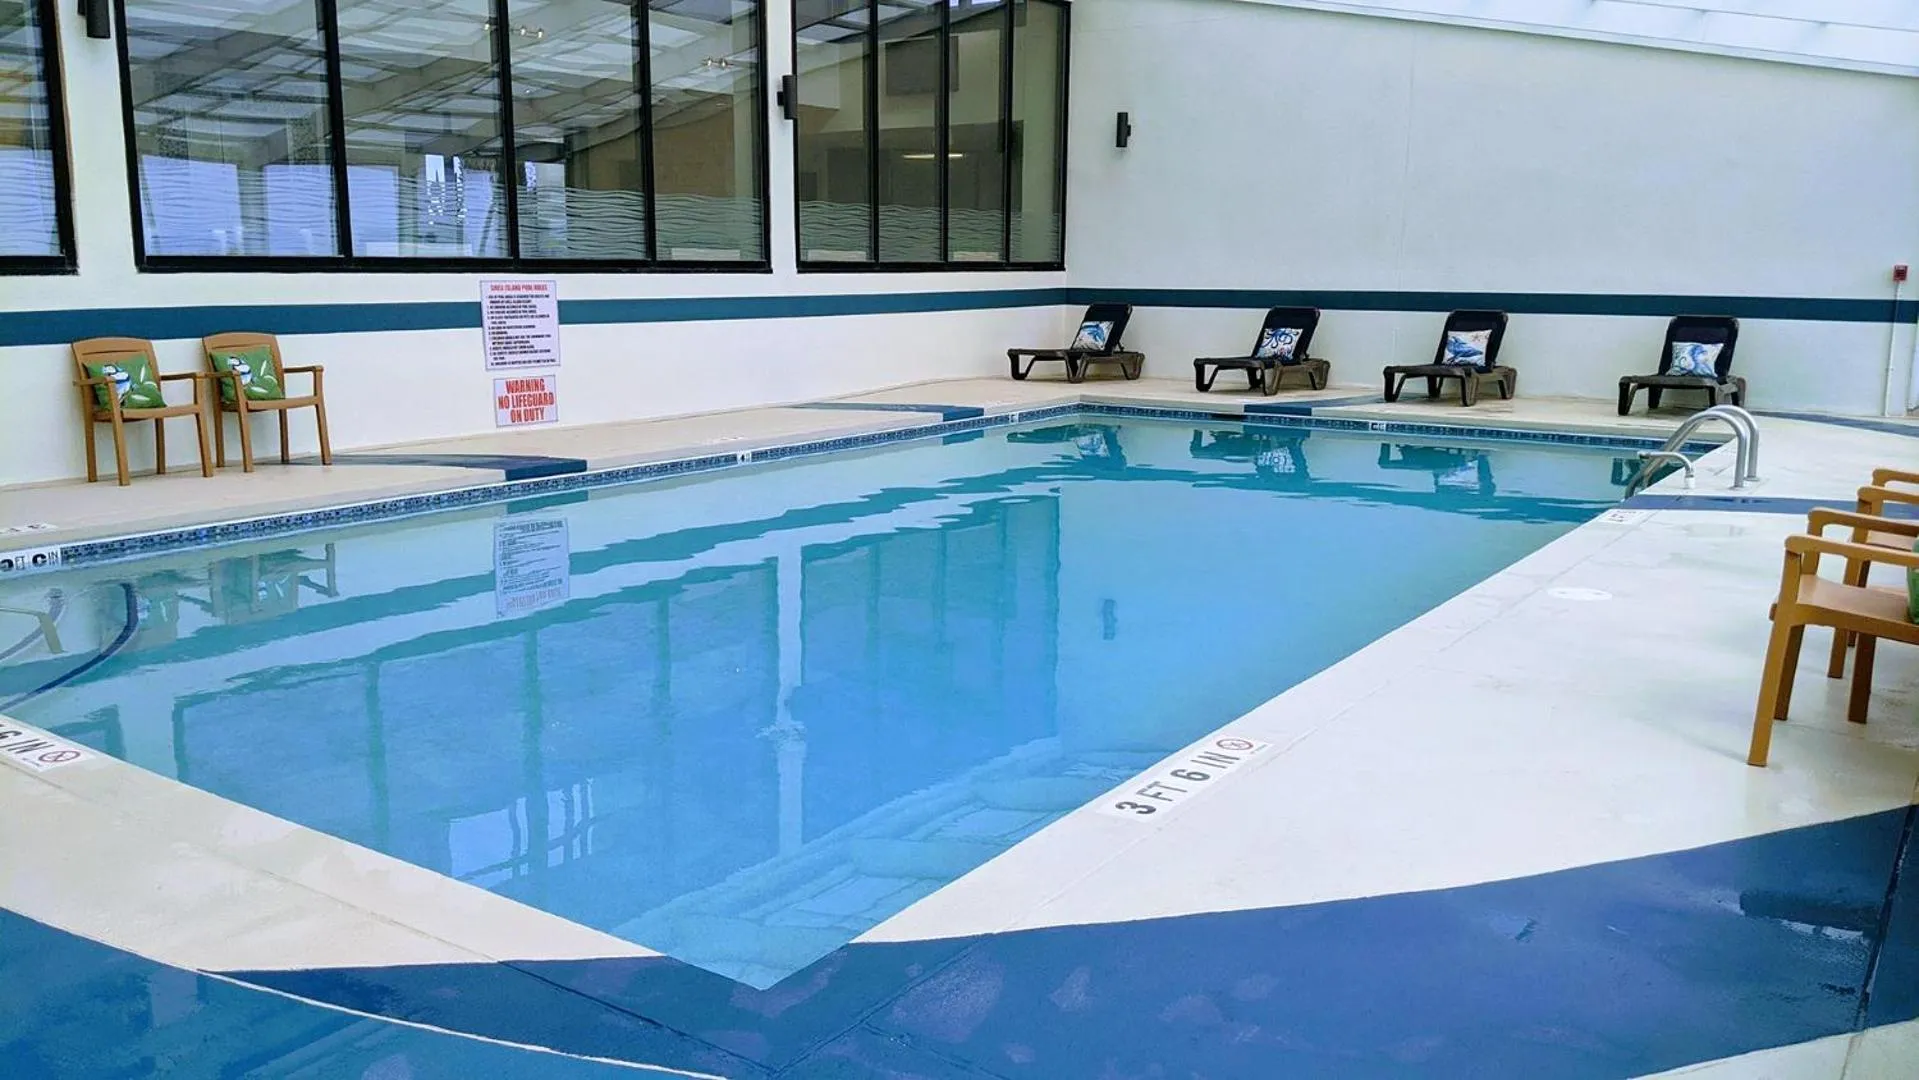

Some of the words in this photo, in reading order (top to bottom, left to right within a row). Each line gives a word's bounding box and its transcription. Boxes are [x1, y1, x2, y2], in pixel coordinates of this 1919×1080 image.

[505, 379, 545, 394] WARNING
[498, 395, 510, 409] NO
[511, 392, 554, 408] LIFEGUARD
[510, 409, 522, 423] ON
[523, 407, 544, 422] DUTY
[0, 738, 56, 755] IN
[1190, 751, 1240, 769] IN
[1170, 768, 1211, 782] 6
[1136, 781, 1188, 802] FT
[1115, 801, 1157, 815] 3
